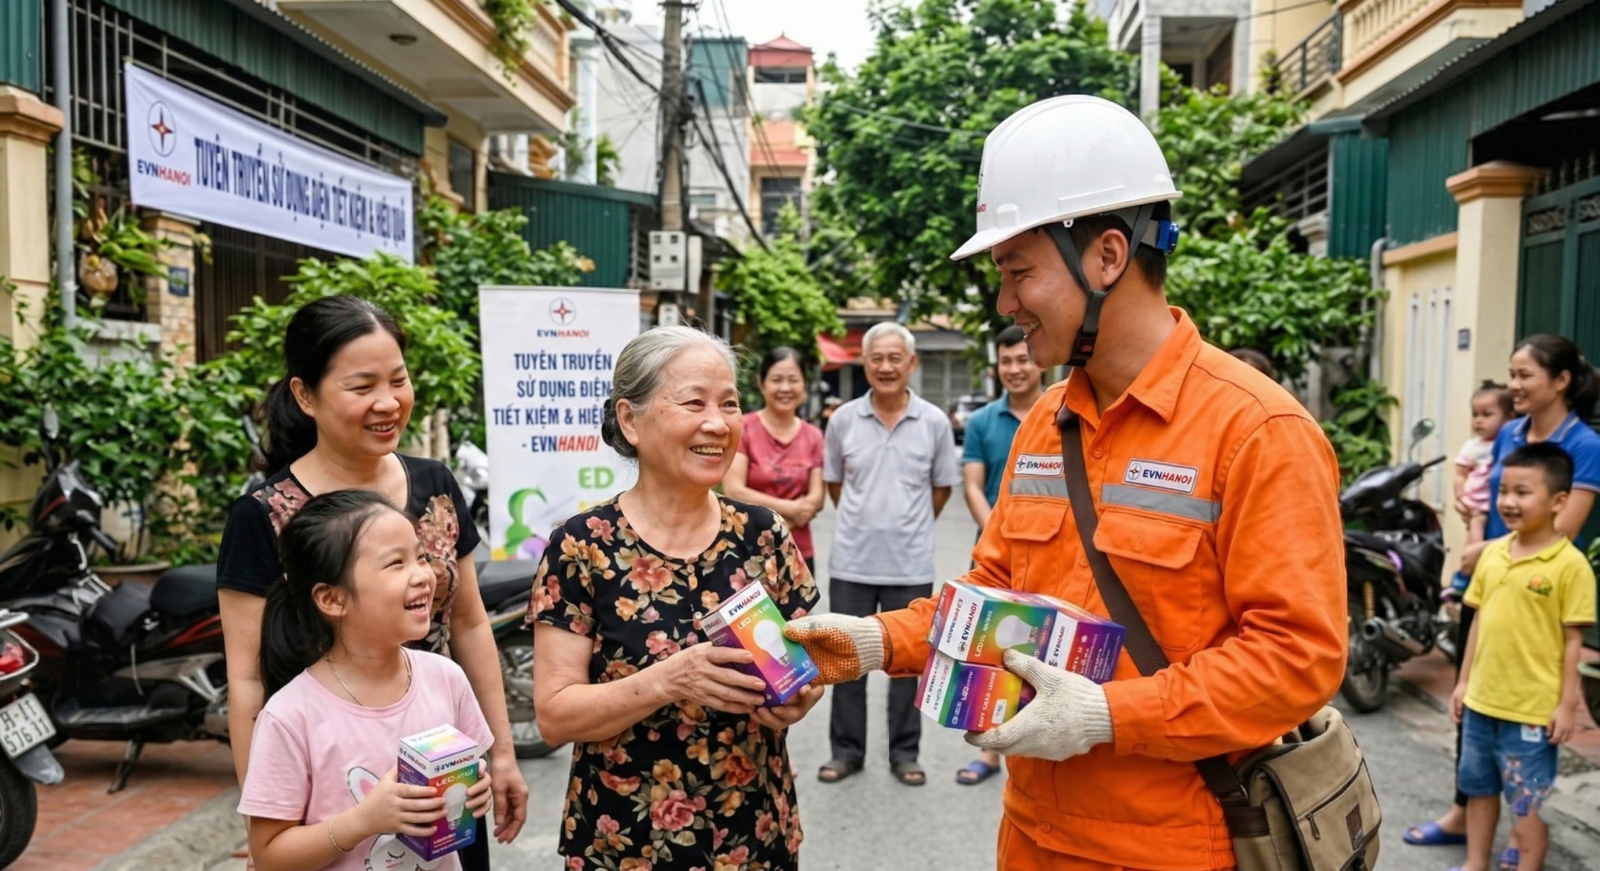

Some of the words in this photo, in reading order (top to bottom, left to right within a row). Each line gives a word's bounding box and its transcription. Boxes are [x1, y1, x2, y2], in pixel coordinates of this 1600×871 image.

[136, 158, 191, 187] EVNHANOI
[194, 133, 229, 193] TUYÊN
[273, 150, 285, 208] SỬ
[332, 176, 347, 227] TIẾT
[369, 198, 375, 234] &
[537, 329, 590, 338] EVNHANOI
[513, 349, 557, 370] TUYÊN
[516, 374, 536, 398] SỬ
[539, 381, 576, 402] DỤNG
[580, 377, 612, 401] ĐIỆN
[493, 402, 521, 426] TIẾT
[525, 404, 559, 429] KIỆM
[564, 408, 573, 425] &
[531, 435, 600, 453] EVNHANOI
[1142, 469, 1193, 485] EVNHANOI
